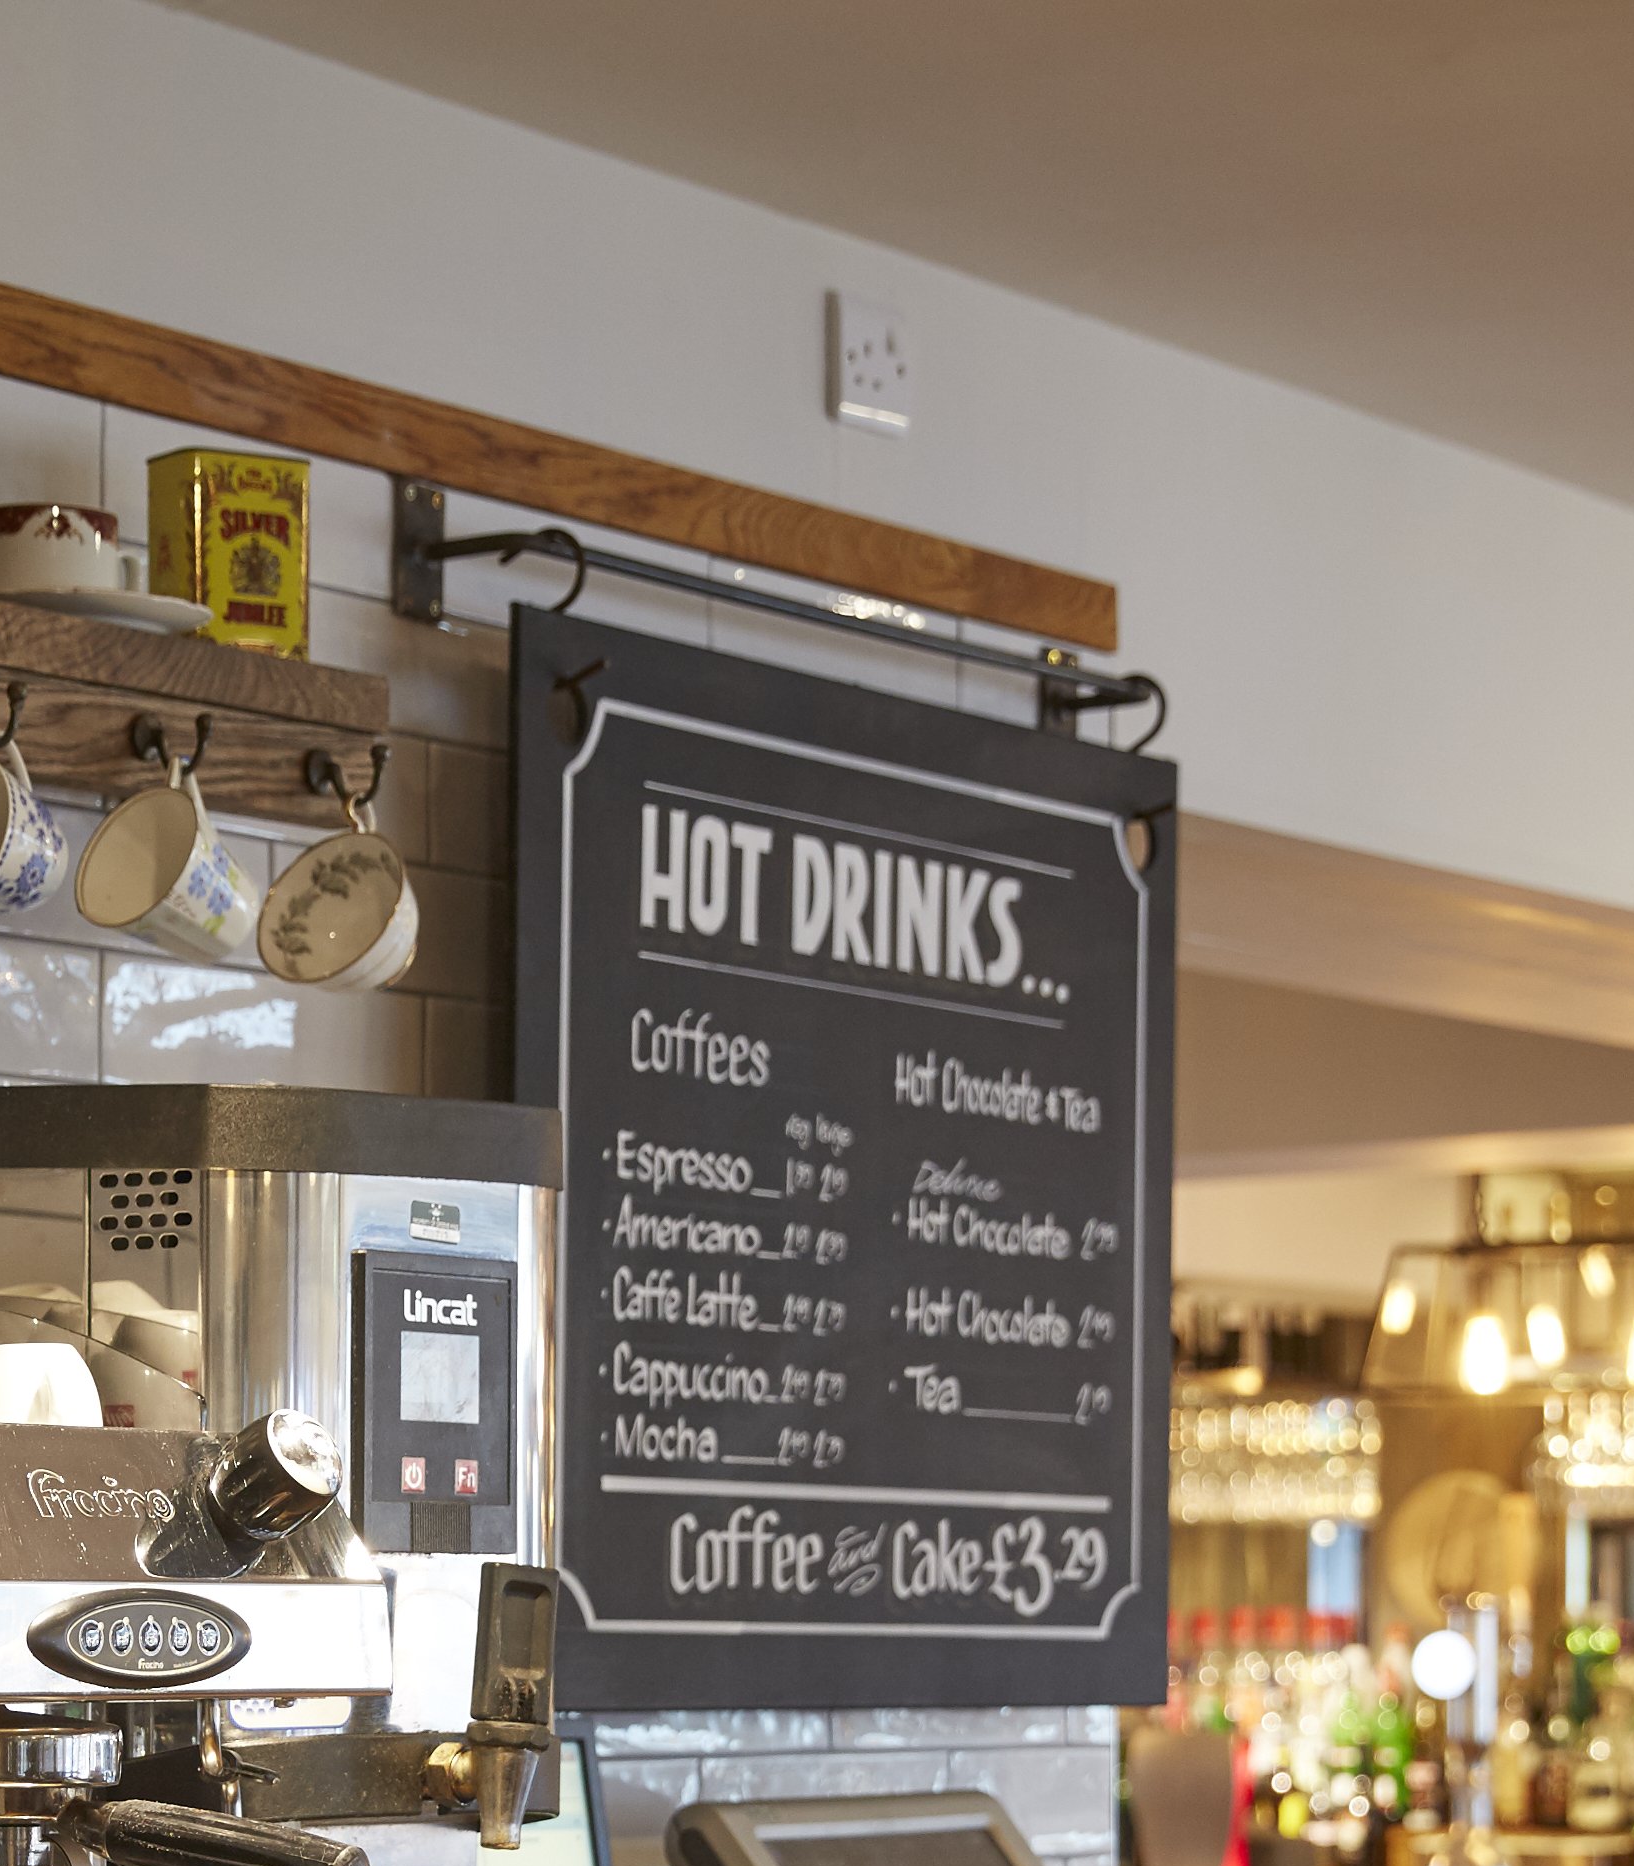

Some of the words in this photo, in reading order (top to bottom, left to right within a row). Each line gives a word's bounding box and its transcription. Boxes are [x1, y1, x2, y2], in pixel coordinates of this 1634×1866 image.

[220, 507, 291, 547] SILVER
[223, 600, 288, 628] JUBILEE
[639, 803, 773, 947] HOT
[630, 1006, 771, 1088] Coffees
[894, 1048, 939, 1107] Hot
[941, 1056, 1043, 1126] Chocolate
[1058, 1085, 1101, 1134] Tea
[616, 1128, 754, 1195] Espresso
[613, 1192, 763, 1256] Americano
[908, 1197, 950, 1246] Hot
[952, 1203, 1073, 1261] Chocolate
[613, 1265, 683, 1324] Caffe
[685, 1269, 759, 1332] Latte
[905, 1286, 954, 1338] Hot
[956, 1289, 1073, 1349] Chocolate
[613, 1339, 771, 1411] Cappuccino
[903, 1363, 962, 1416] Tea
[615, 1412, 719, 1464] Mocha
[458, 1466, 476, 1488] Fn
[670, 1503, 824, 1595] Coffee
[892, 1519, 983, 1600] Cake
